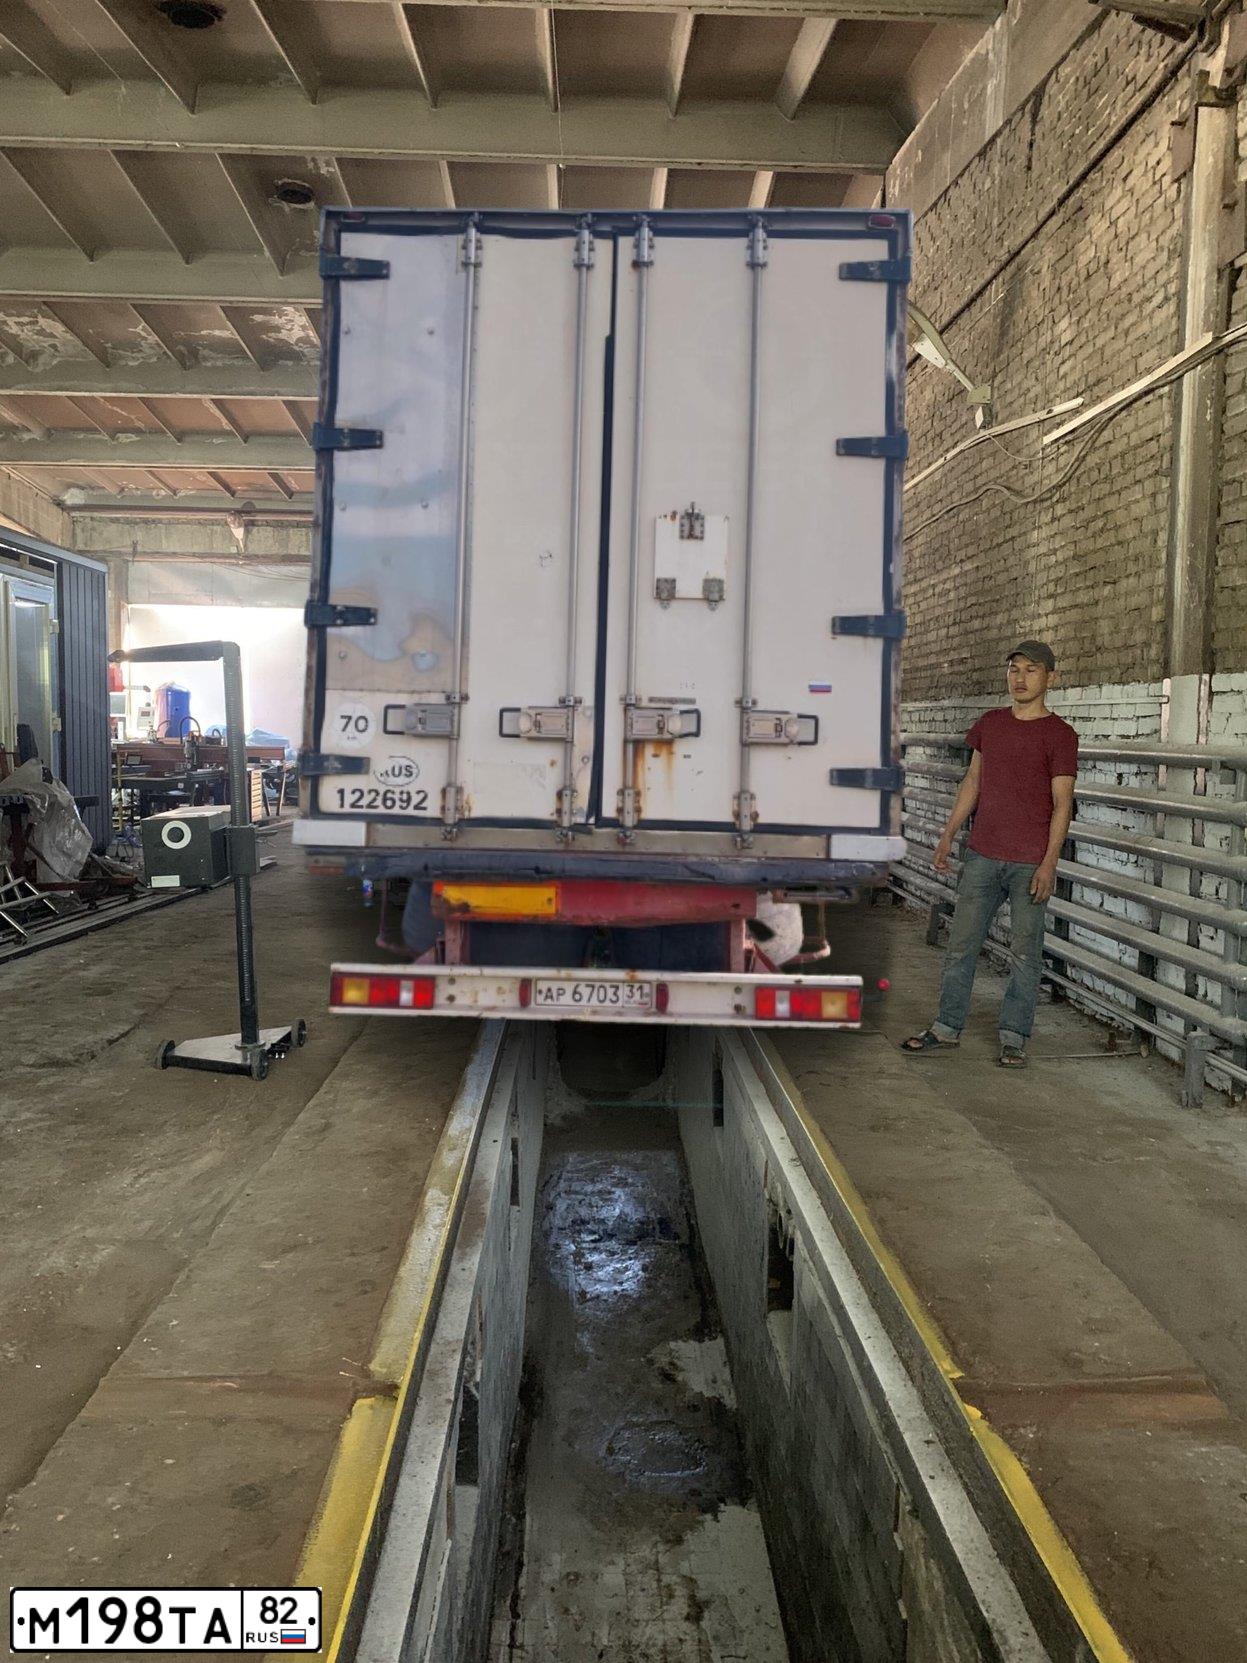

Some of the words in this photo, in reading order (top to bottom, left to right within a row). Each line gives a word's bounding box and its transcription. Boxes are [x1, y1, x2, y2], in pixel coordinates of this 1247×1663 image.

[340, 715, 369, 733] 70
[337, 788, 429, 811] 122692
[572, 984, 620, 1004] 6703
[626, 984, 643, 1000] 31
